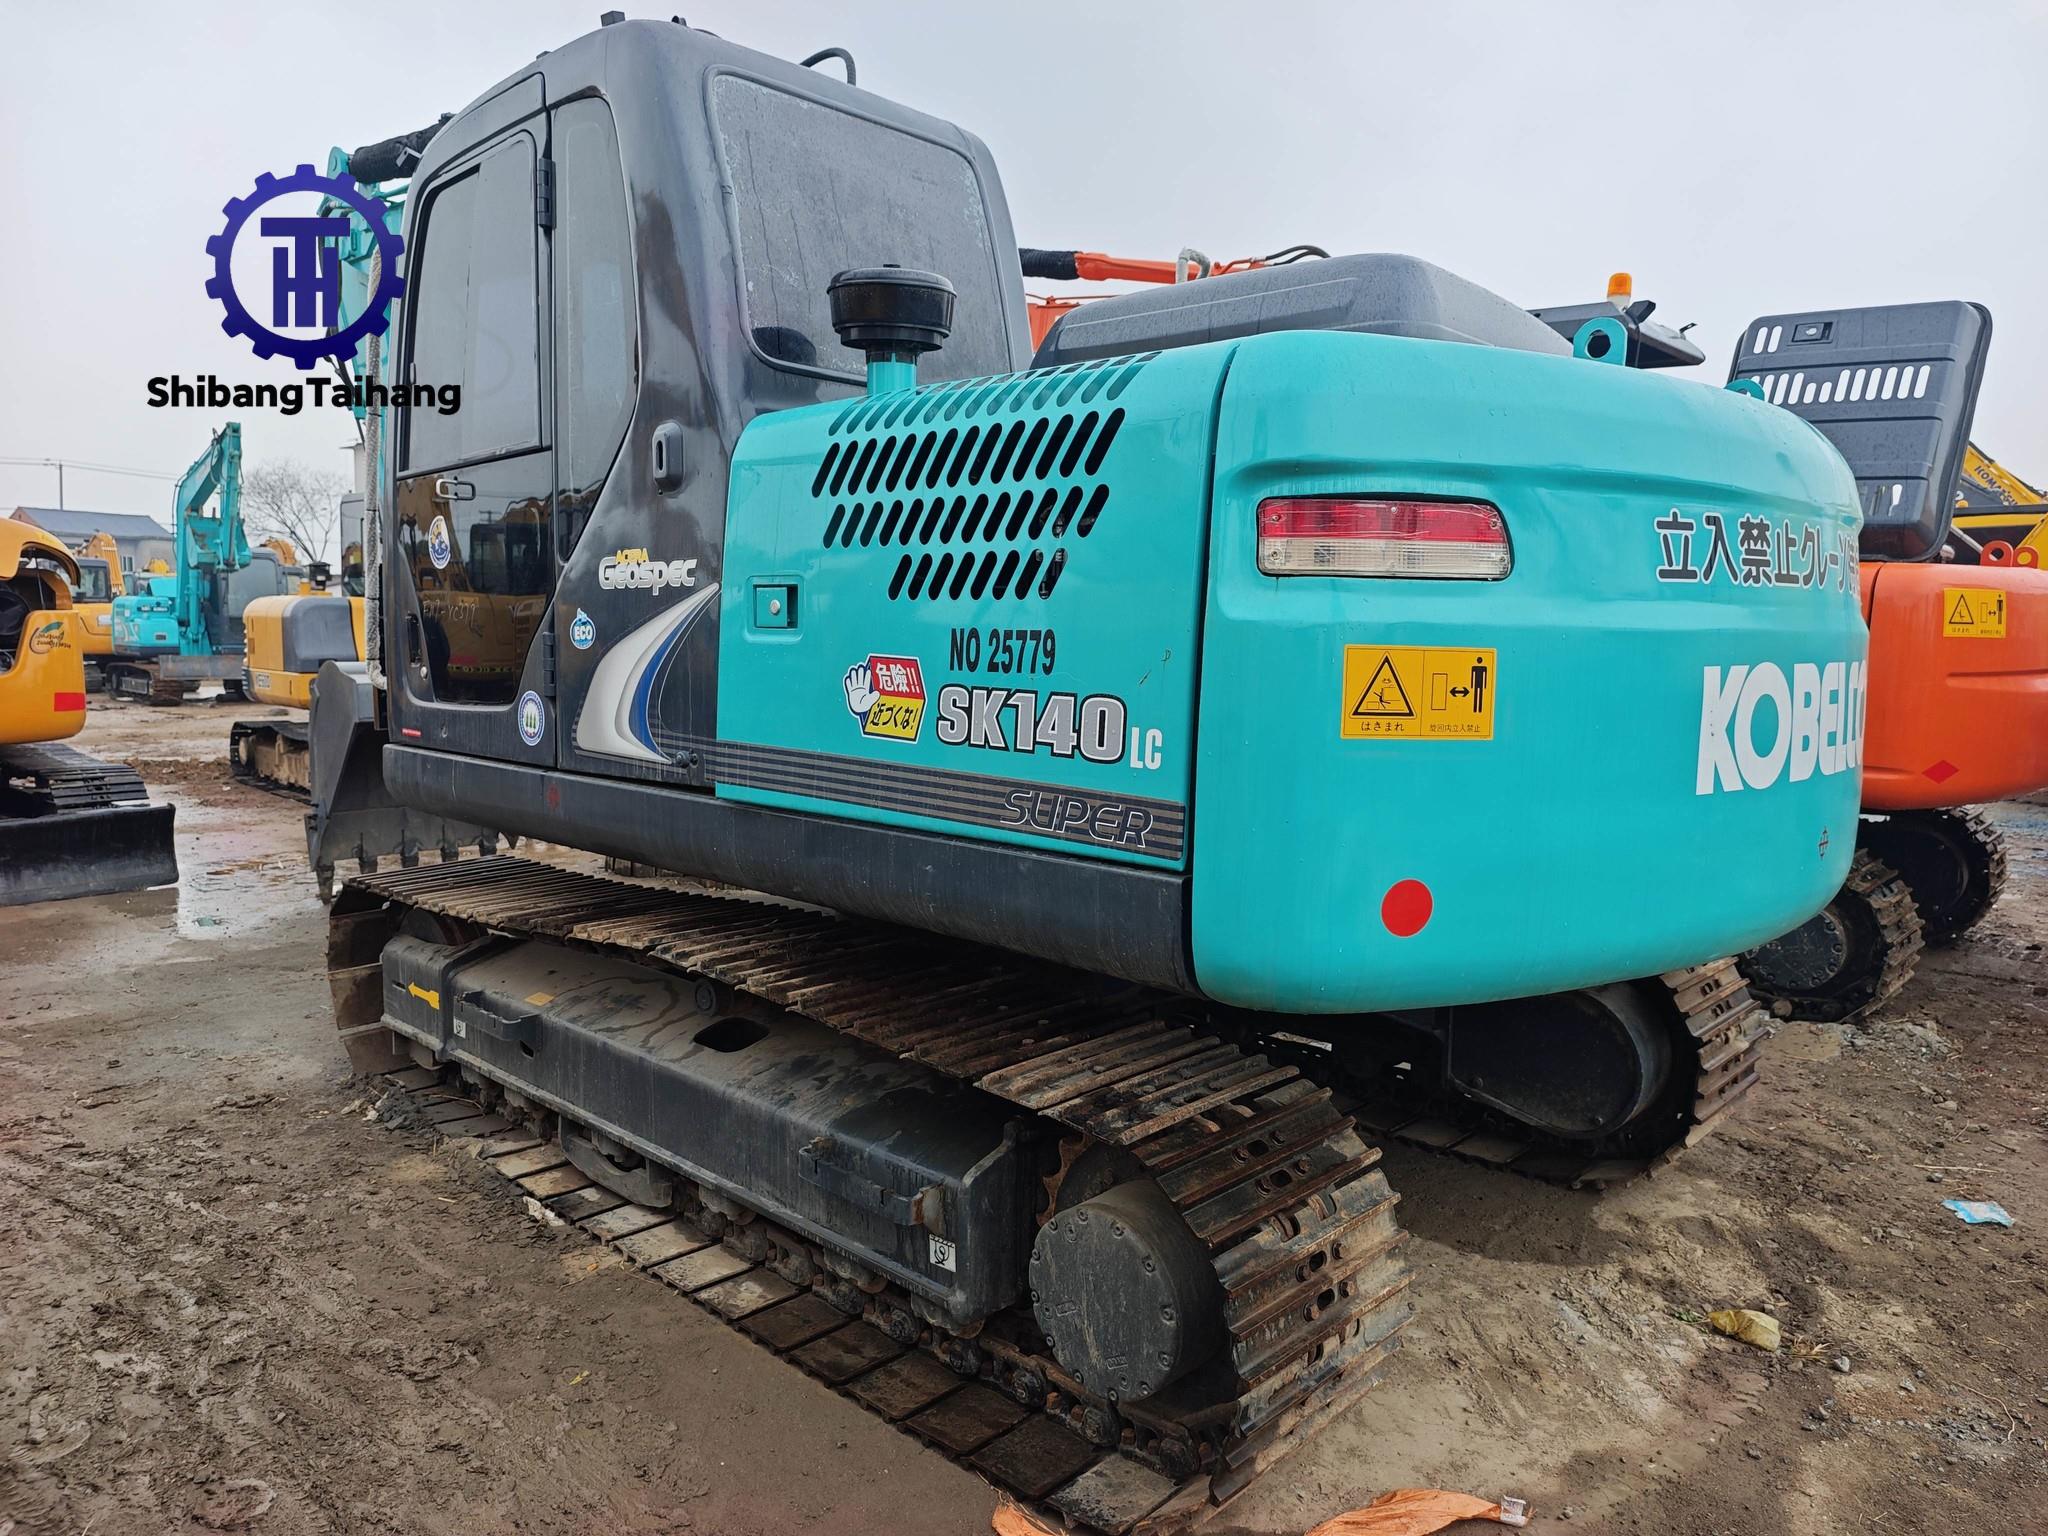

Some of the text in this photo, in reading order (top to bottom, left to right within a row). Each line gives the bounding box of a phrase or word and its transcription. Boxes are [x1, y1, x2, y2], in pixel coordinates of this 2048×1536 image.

[574, 625, 593, 640] ECO
[950, 627, 1056, 676] NO 25779
[937, 683, 1163, 770] SK140 LC
[1000, 788, 1154, 848] SUPER
